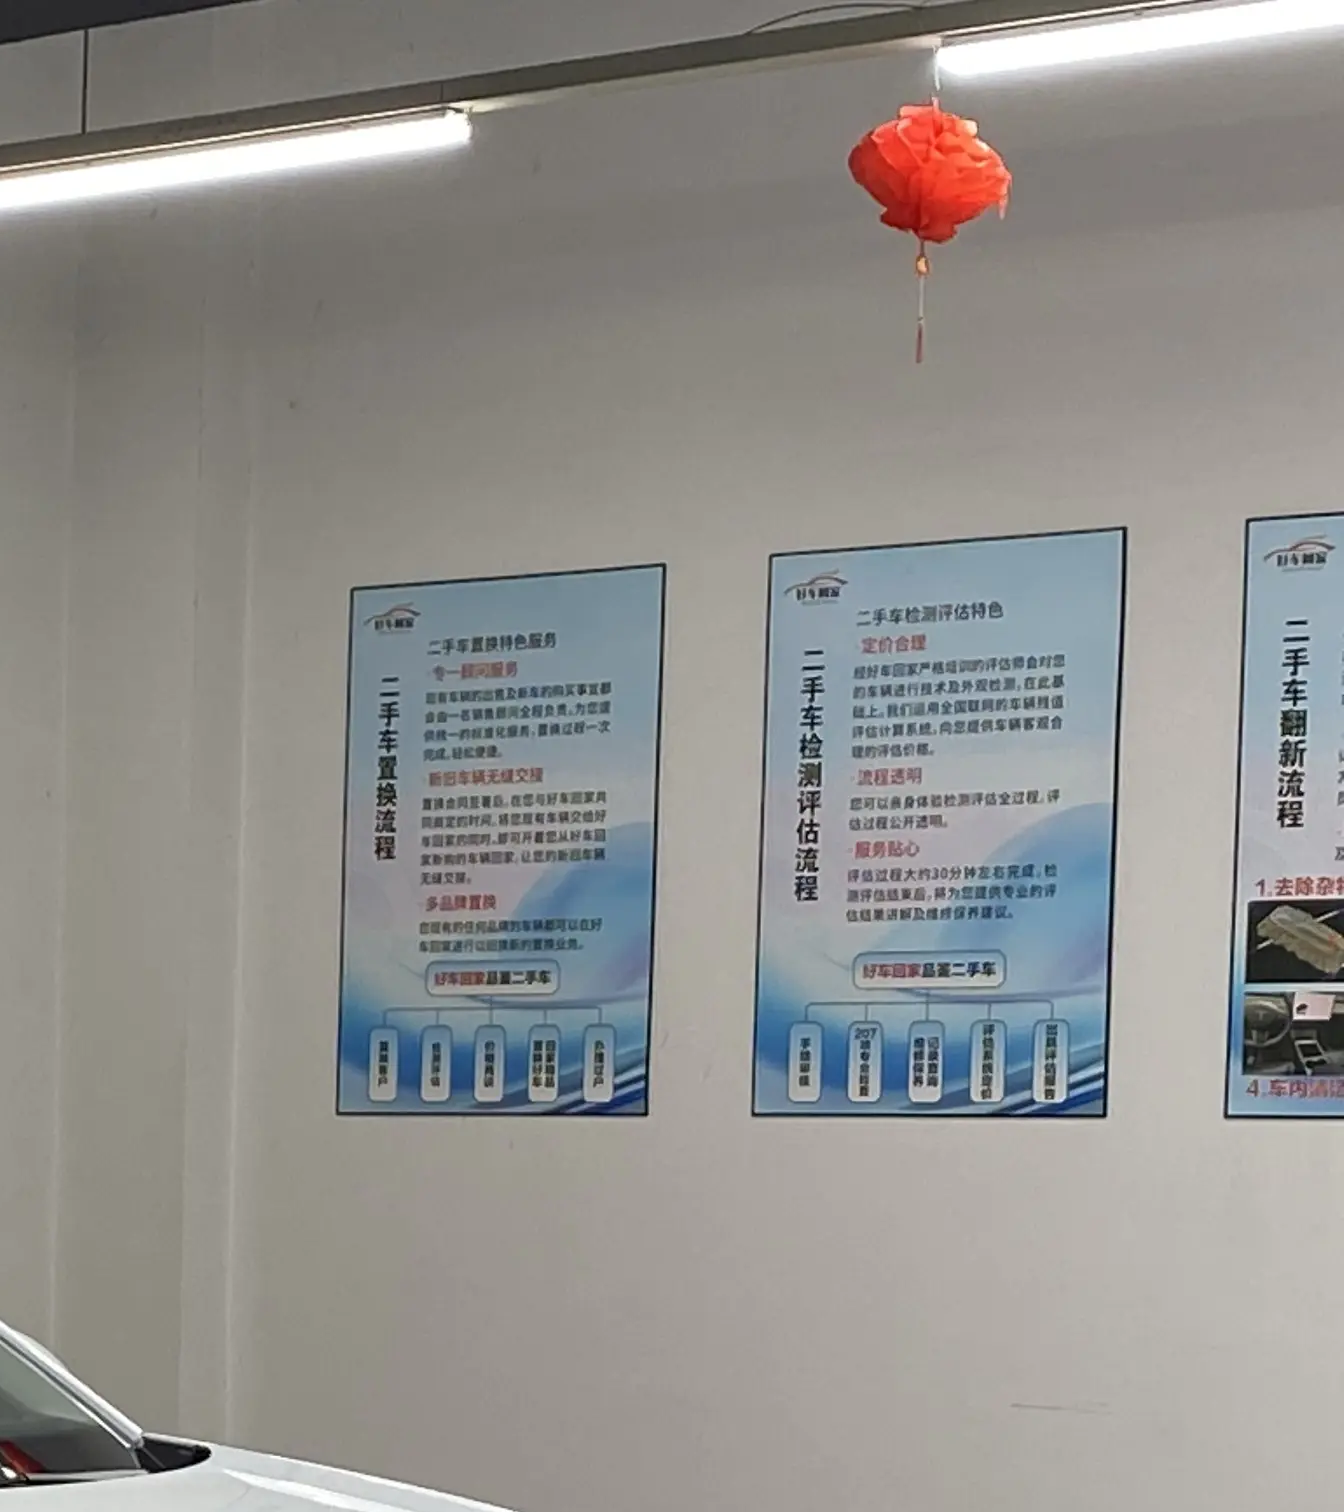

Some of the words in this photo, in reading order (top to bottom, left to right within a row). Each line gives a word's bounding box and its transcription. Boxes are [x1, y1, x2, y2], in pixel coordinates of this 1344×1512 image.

[856, 601, 1004, 627] 二手车检测评估特色
[861, 634, 927, 655] 定价合理
[1276, 620, 1310, 829] 二手车翻新流程
[374, 677, 400, 861] 二手车置换流程
[794, 650, 825, 902] 二手车检测评估流程
[857, 766, 923, 787] 流程透明
[854, 840, 921, 860] 服务贴心
